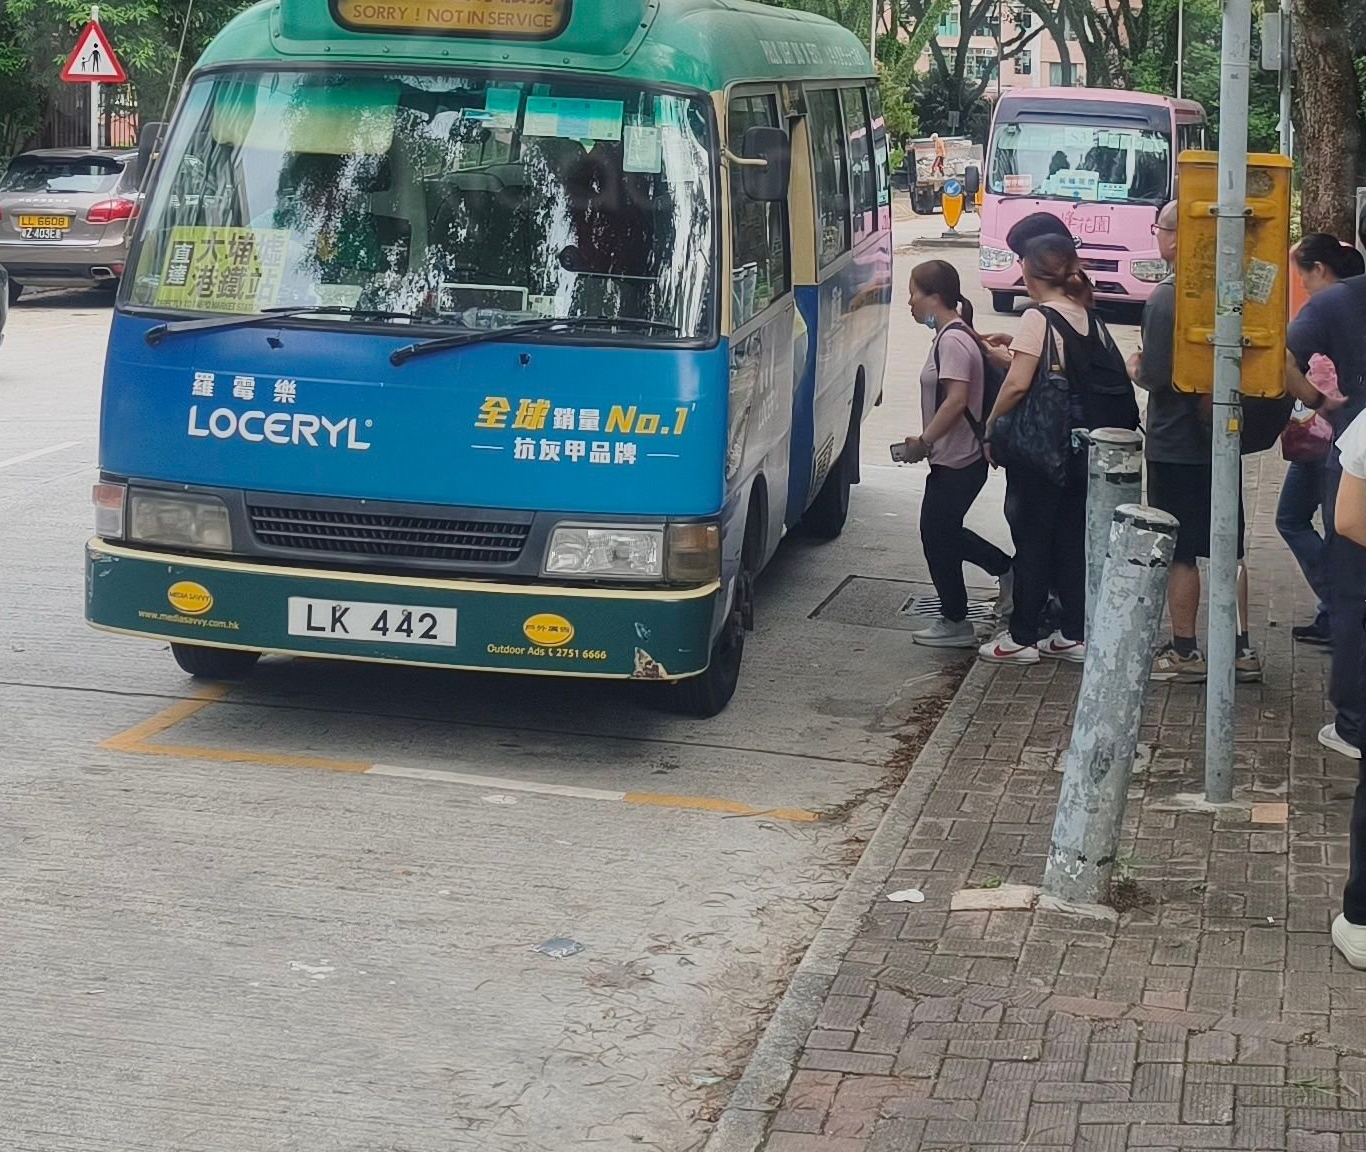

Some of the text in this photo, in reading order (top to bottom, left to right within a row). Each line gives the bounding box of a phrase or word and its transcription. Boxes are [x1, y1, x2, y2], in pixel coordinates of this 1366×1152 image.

[353, 5, 408, 20] SORRY
[427, 9, 464, 24] NOT
[467, 11, 484, 25] IN
[488, 11, 553, 28] SERVICE
[21, 216, 34, 226] LL
[188, 405, 371, 450] LOCERYL
[513, 437, 637, 465] 抗灰甲品牌
[138, 610, 240, 630] www.mediasavvy.com.hk
[306, 604, 438, 640] LK 442
[487, 644, 607, 659] Outdoor Ads 2751 6666
